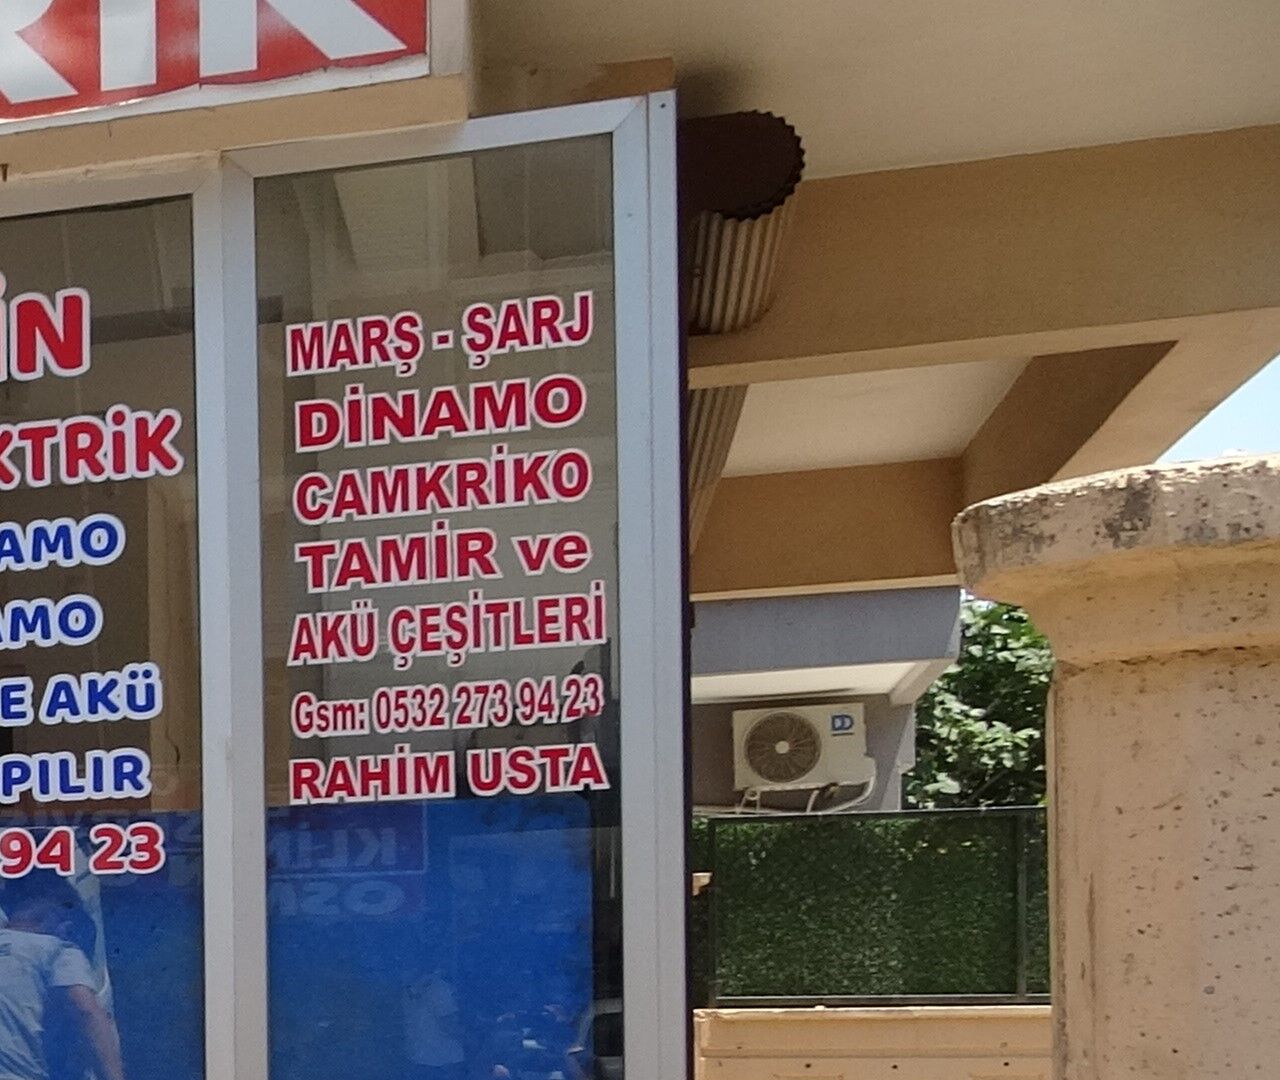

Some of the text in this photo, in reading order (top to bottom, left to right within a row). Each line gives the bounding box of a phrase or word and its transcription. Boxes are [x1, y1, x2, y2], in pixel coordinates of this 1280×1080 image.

[288, 314, 422, 375] MARŞ
[465, 293, 592, 367] ŞARJ
[297, 375, 584, 449] DİNAMO
[295, 444, 590, 522] CAMKRİKO
[297, 520, 590, 590] TAMİR ve
[290, 580, 606, 669] AKÜ ÇEŞİTLERİ
[44, 667, 158, 719] AKÜ
[293, 675, 603, 735] Gsm: 0532 273 94 23
[291, 743, 607, 802] RAHİM USTA
[89, 823, 164, 872] 23
